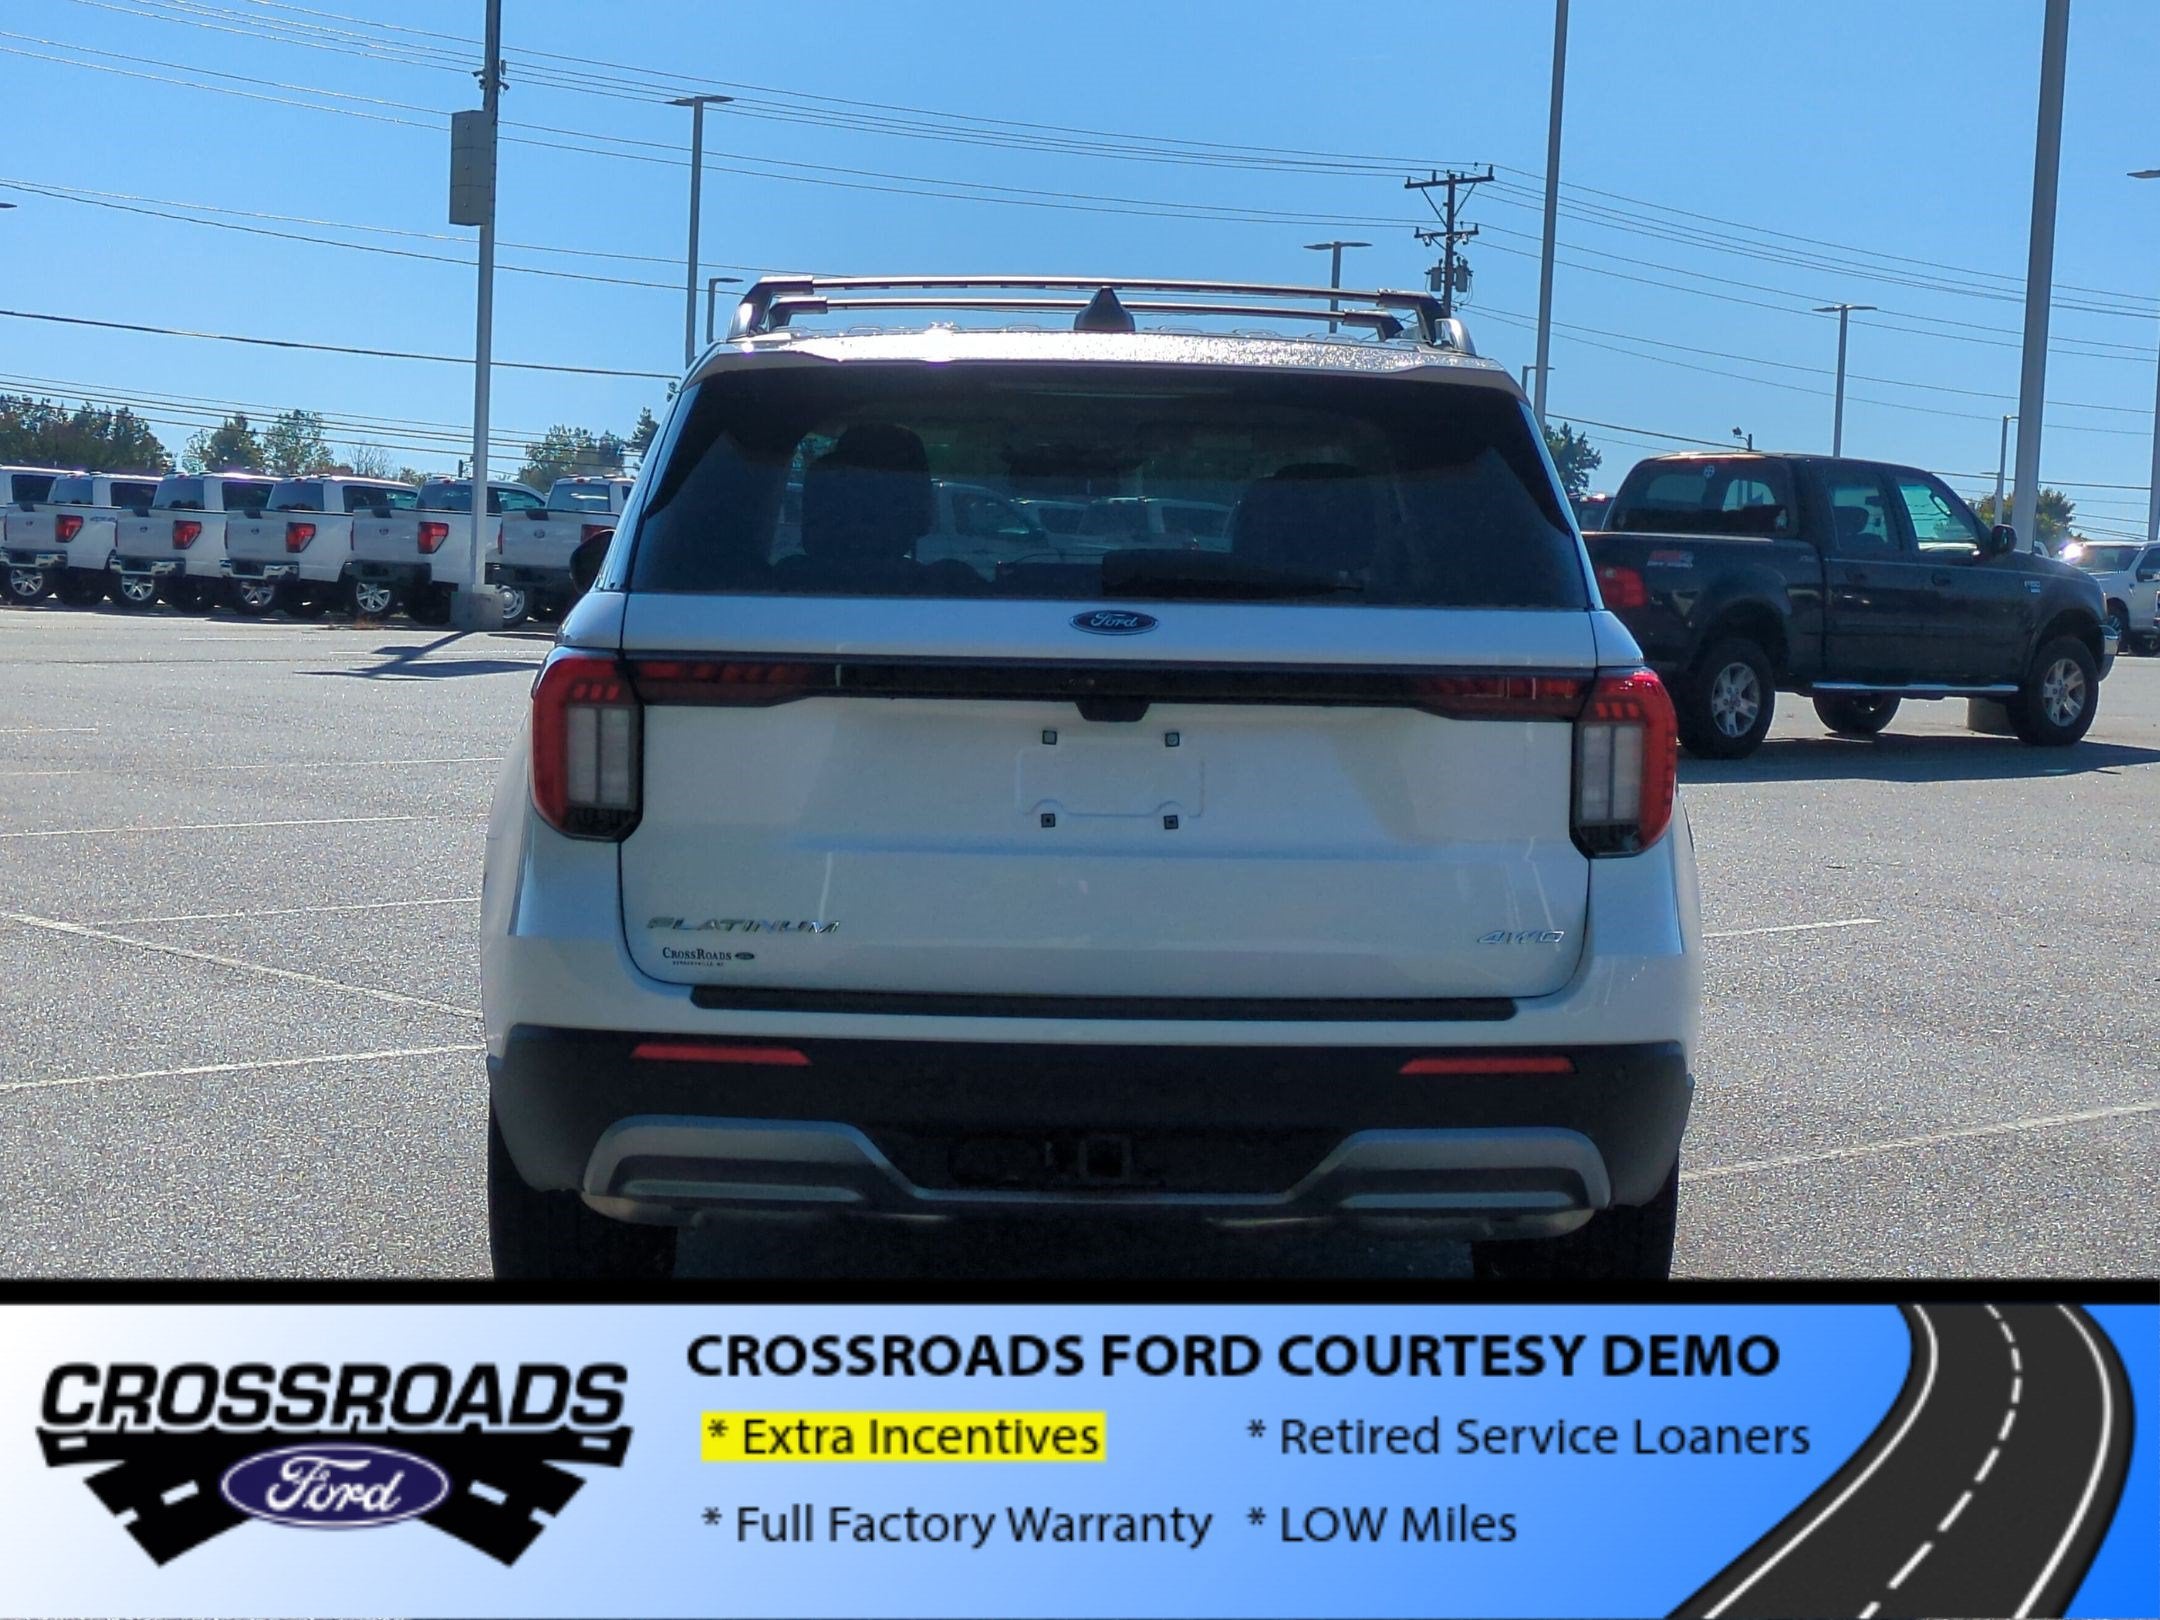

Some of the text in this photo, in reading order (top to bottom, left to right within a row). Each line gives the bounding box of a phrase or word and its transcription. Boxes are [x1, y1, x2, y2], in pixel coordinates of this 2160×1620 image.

[1090, 611, 1138, 628] Ford
[647, 916, 841, 935] PLATINUM
[1477, 929, 1565, 945] 4WD
